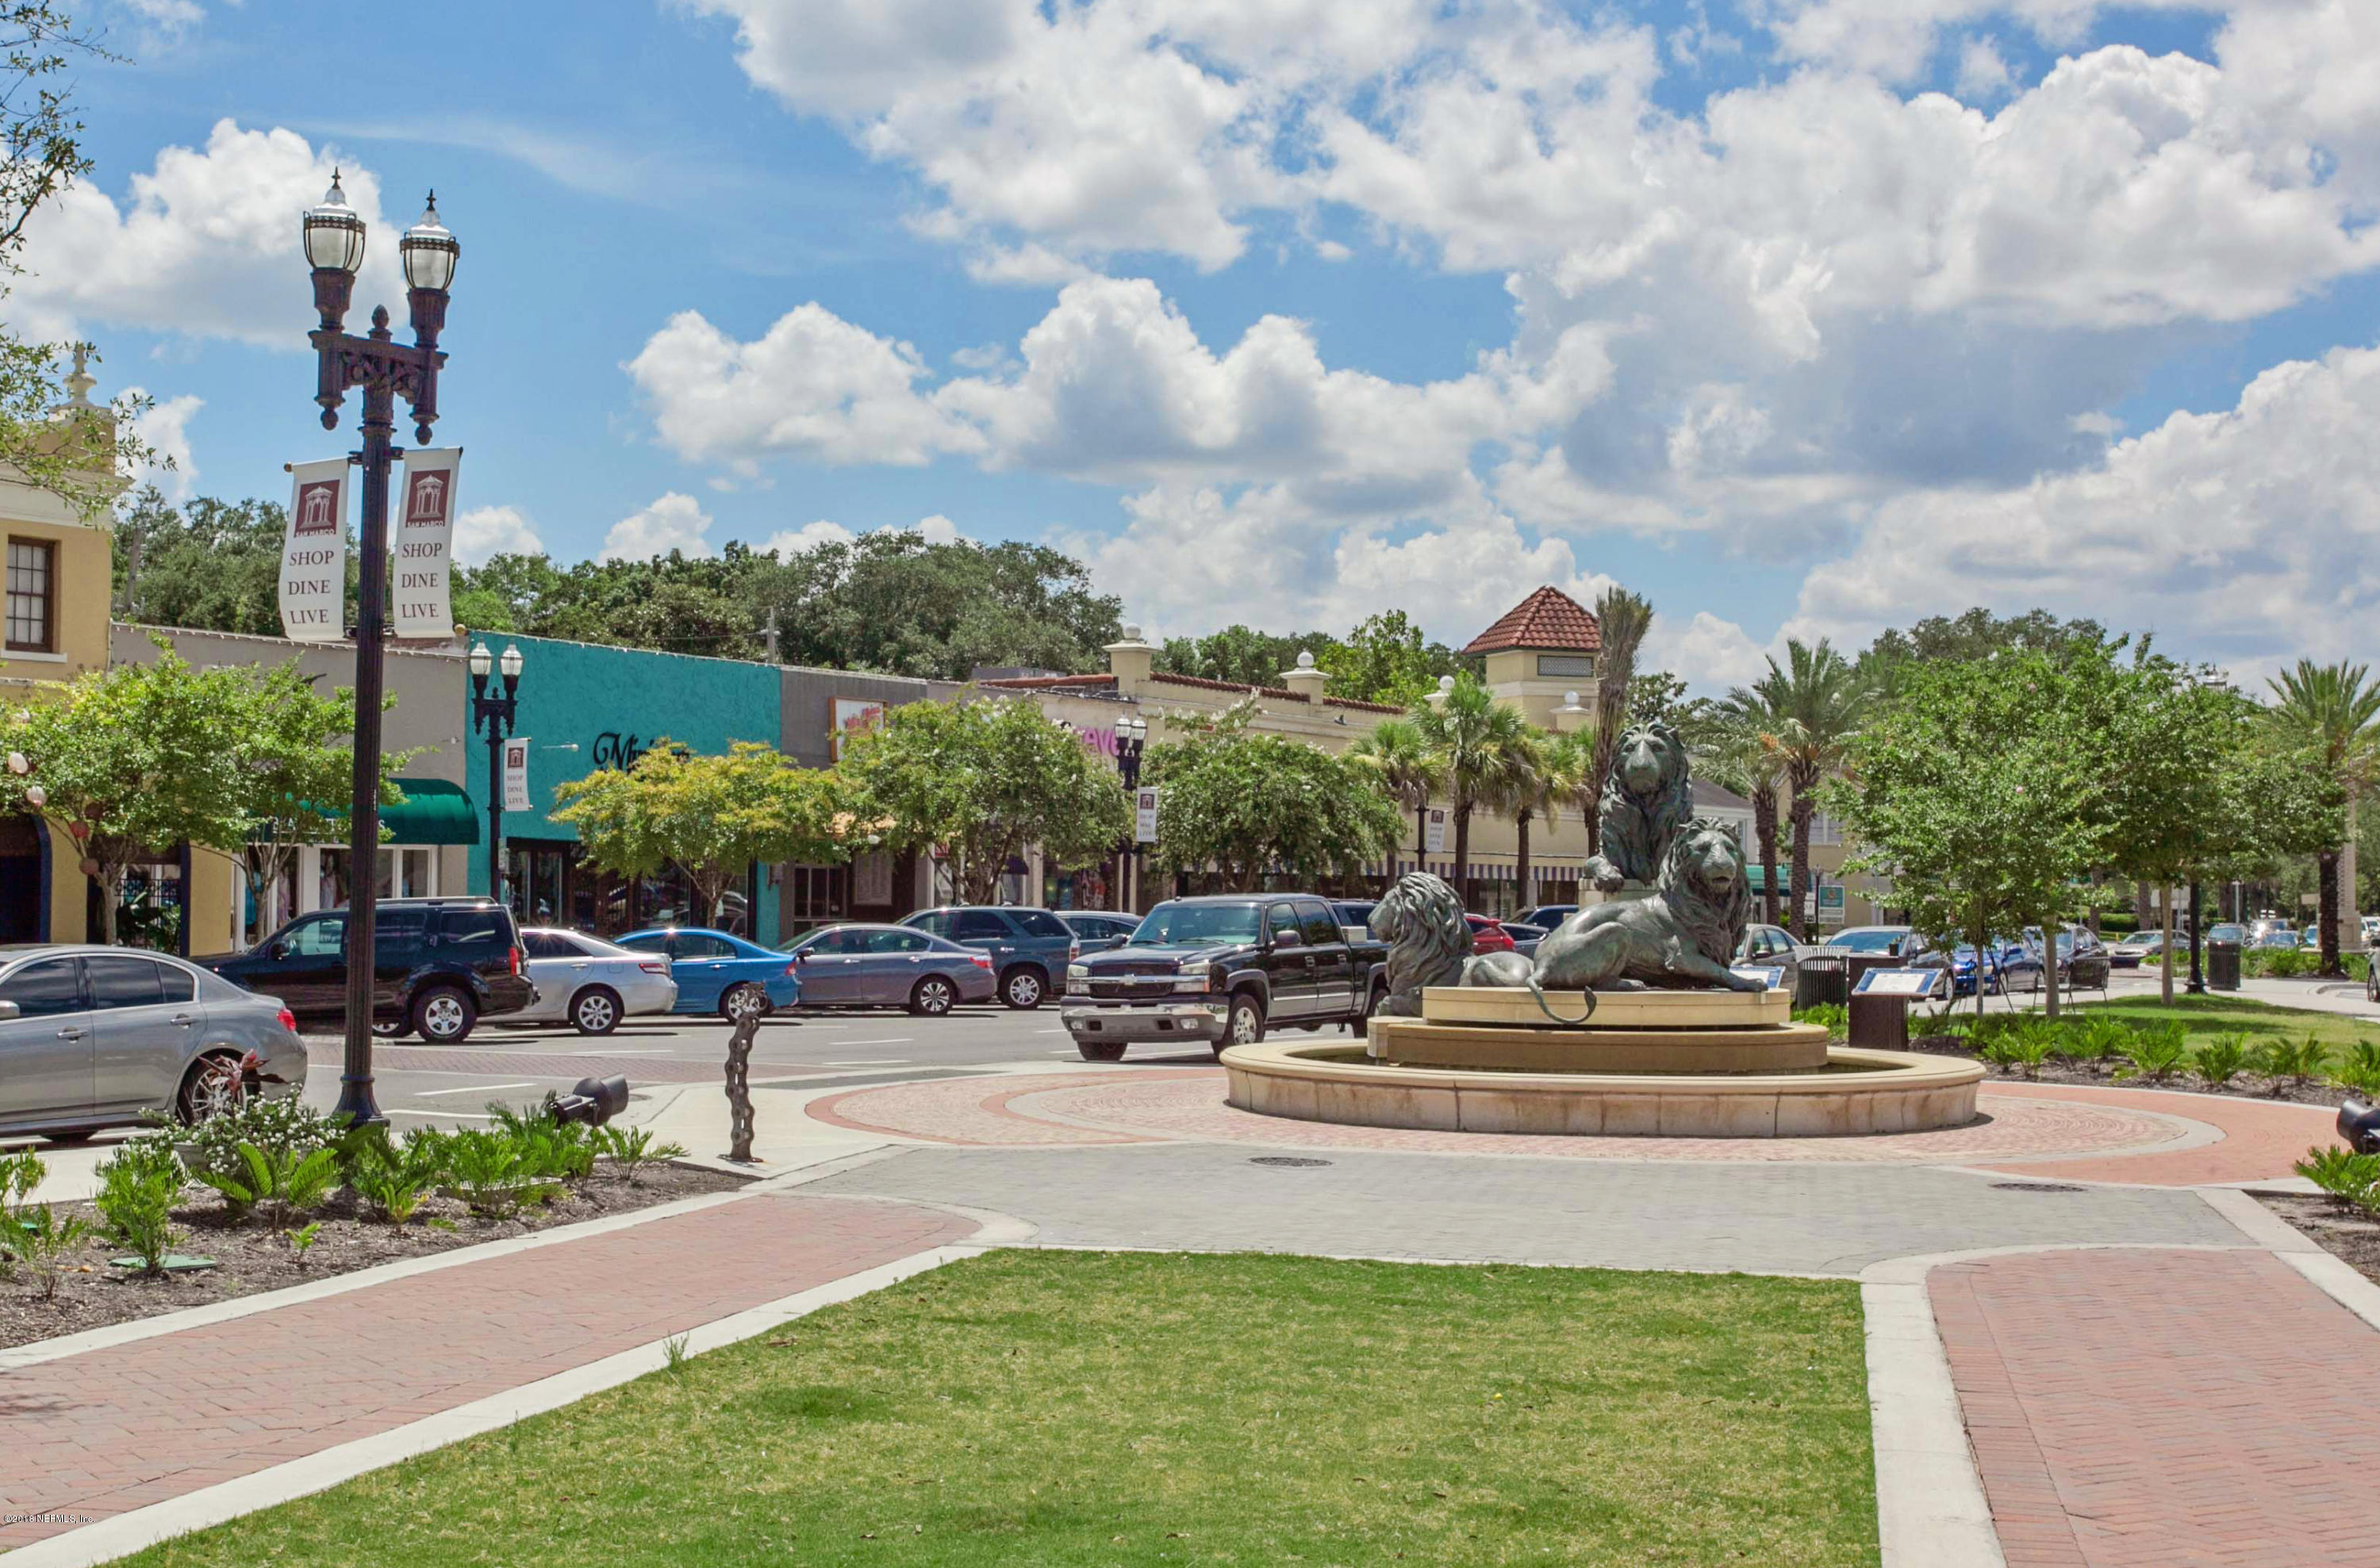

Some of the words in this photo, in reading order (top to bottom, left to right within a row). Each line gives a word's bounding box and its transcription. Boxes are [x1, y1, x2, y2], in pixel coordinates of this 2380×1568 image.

[402, 542, 443, 558] SHOP
[289, 550, 335, 566] SHOP
[288, 580, 331, 596] DINE
[401, 573, 439, 588] DINE
[290, 609, 329, 624] LIVE
[402, 604, 439, 619] LIVE
